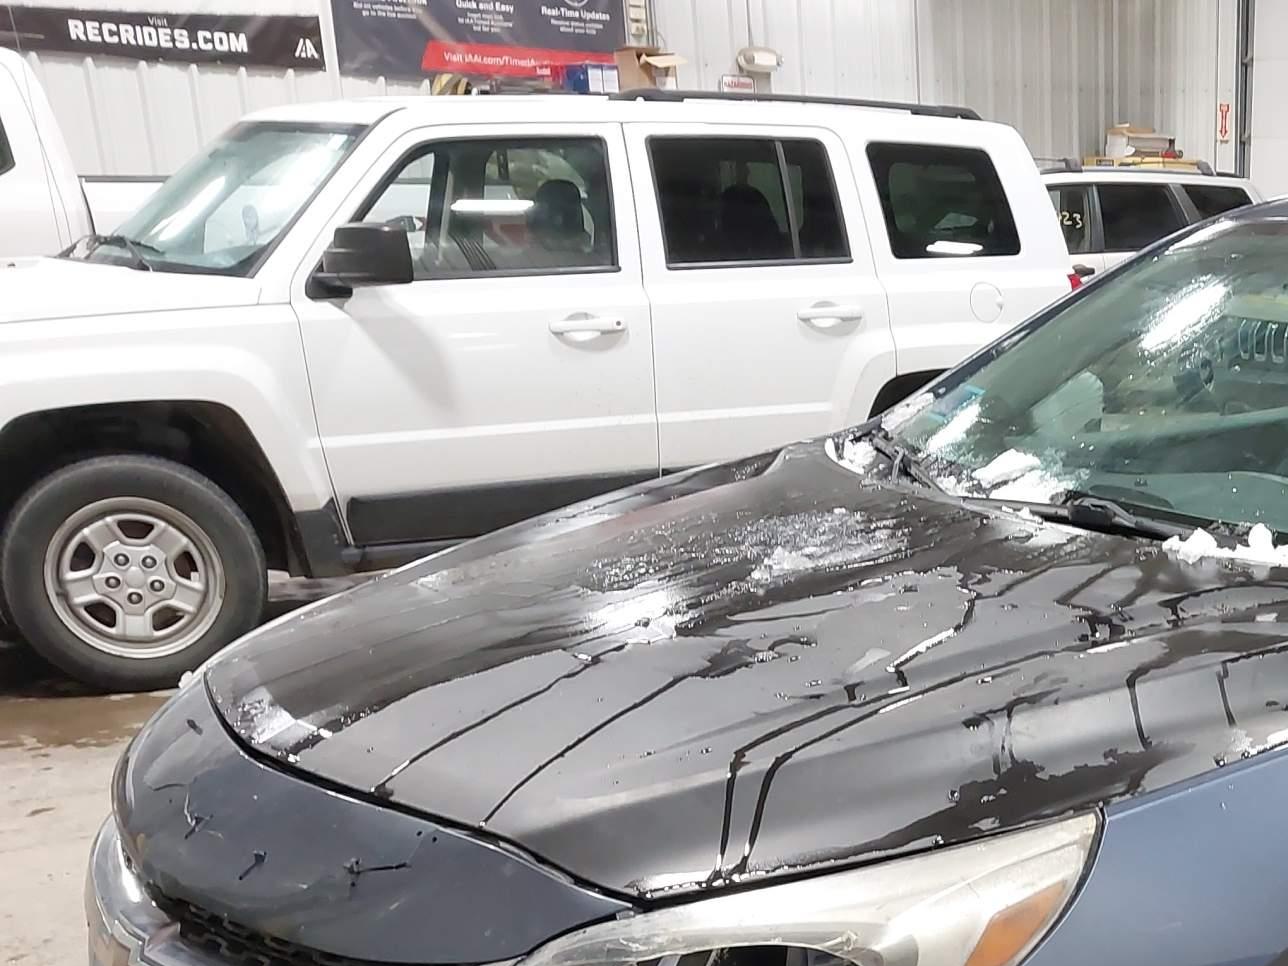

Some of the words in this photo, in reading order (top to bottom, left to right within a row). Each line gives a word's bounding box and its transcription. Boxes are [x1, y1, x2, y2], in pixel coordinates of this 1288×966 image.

[478, 1, 494, 11] and
[495, 1, 514, 14] Easy
[541, 5, 580, 18] Real-Time
[580, 8, 610, 21] Updates
[147, 16, 168, 27] Visit
[67, 18, 249, 53] RECRIDES.COM
[443, 51, 464, 64] Visit
[1058, 211, 1083, 229] 23
